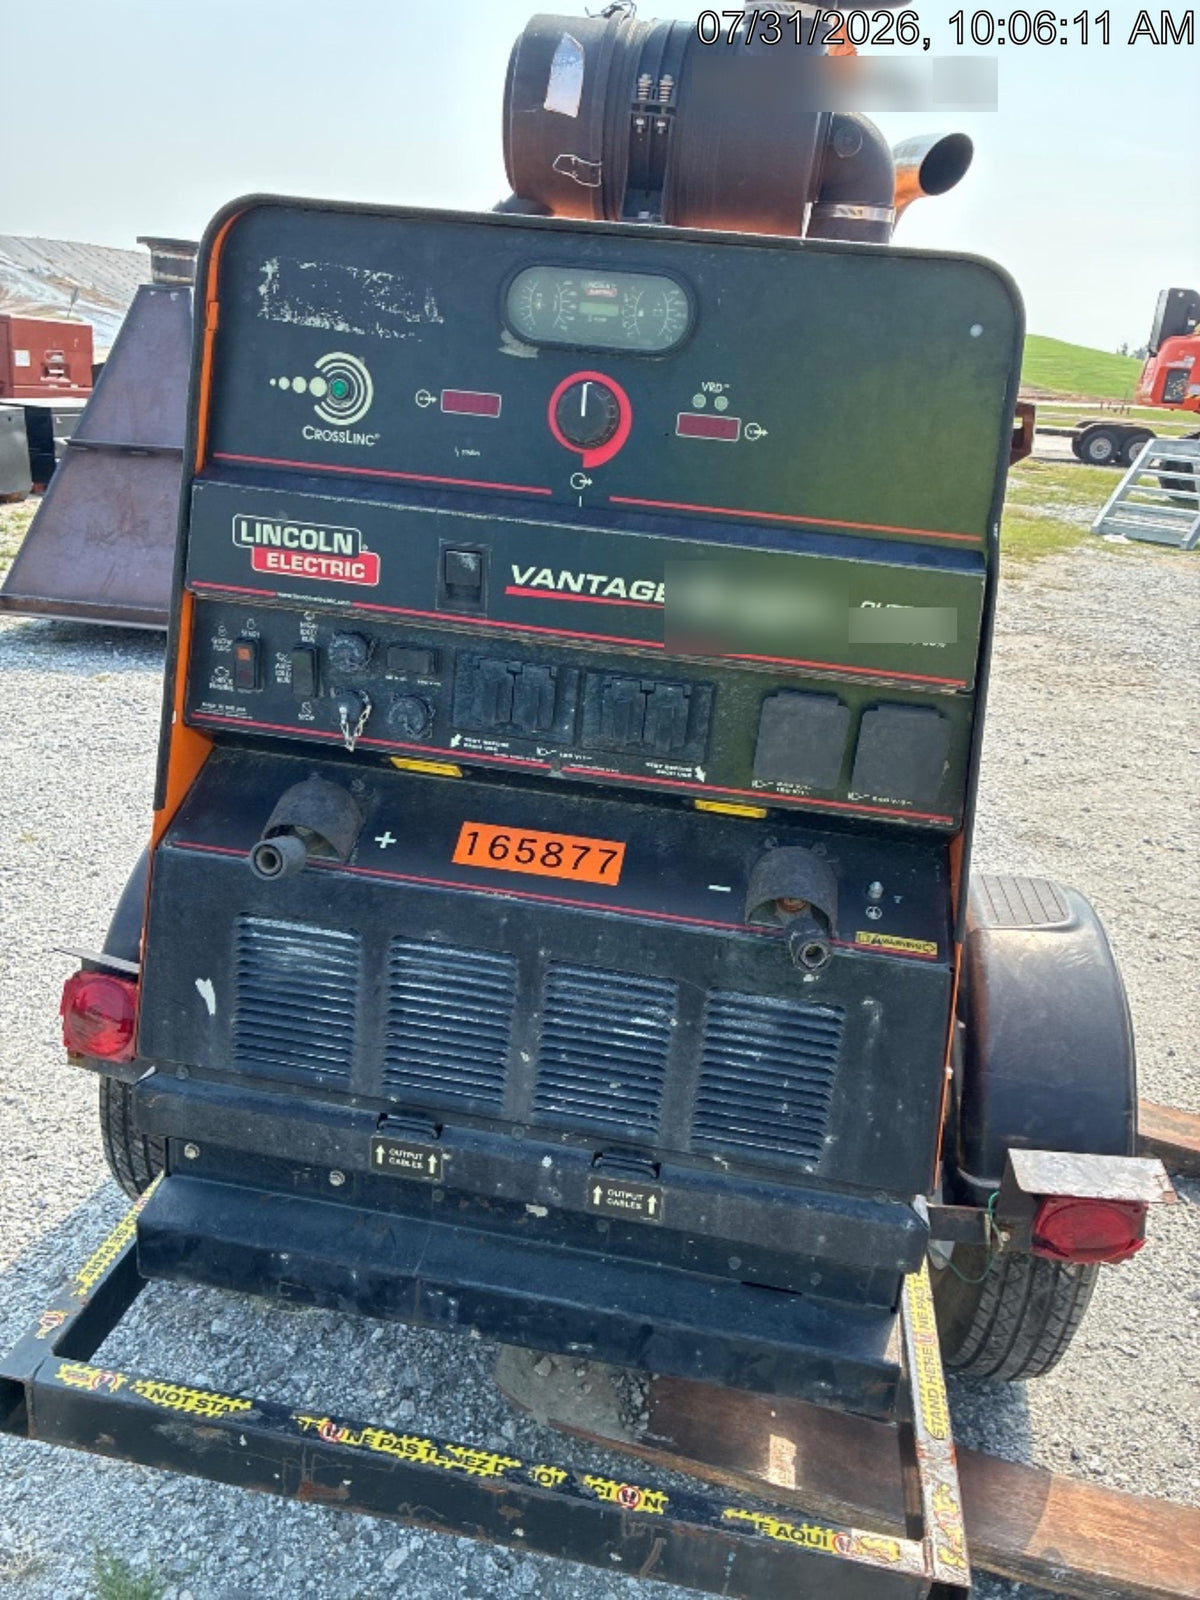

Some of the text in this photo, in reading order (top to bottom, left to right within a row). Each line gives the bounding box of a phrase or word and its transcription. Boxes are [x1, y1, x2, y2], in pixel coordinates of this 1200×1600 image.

[241, 521, 353, 556] LINCOLN
[266, 552, 366, 579] ELECTRIC
[467, 831, 618, 875] 165877
[389, 1148, 424, 1160] OUTPUT
[607, 1189, 644, 1201] OUTPUT
[149, 1386, 195, 1405] NOT
[195, 1398, 241, 1413] STA
[922, 1346, 945, 1438] STAND HERE
[379, 1438, 418, 1455] PAS
[775, 1524, 828, 1548] AQUI
